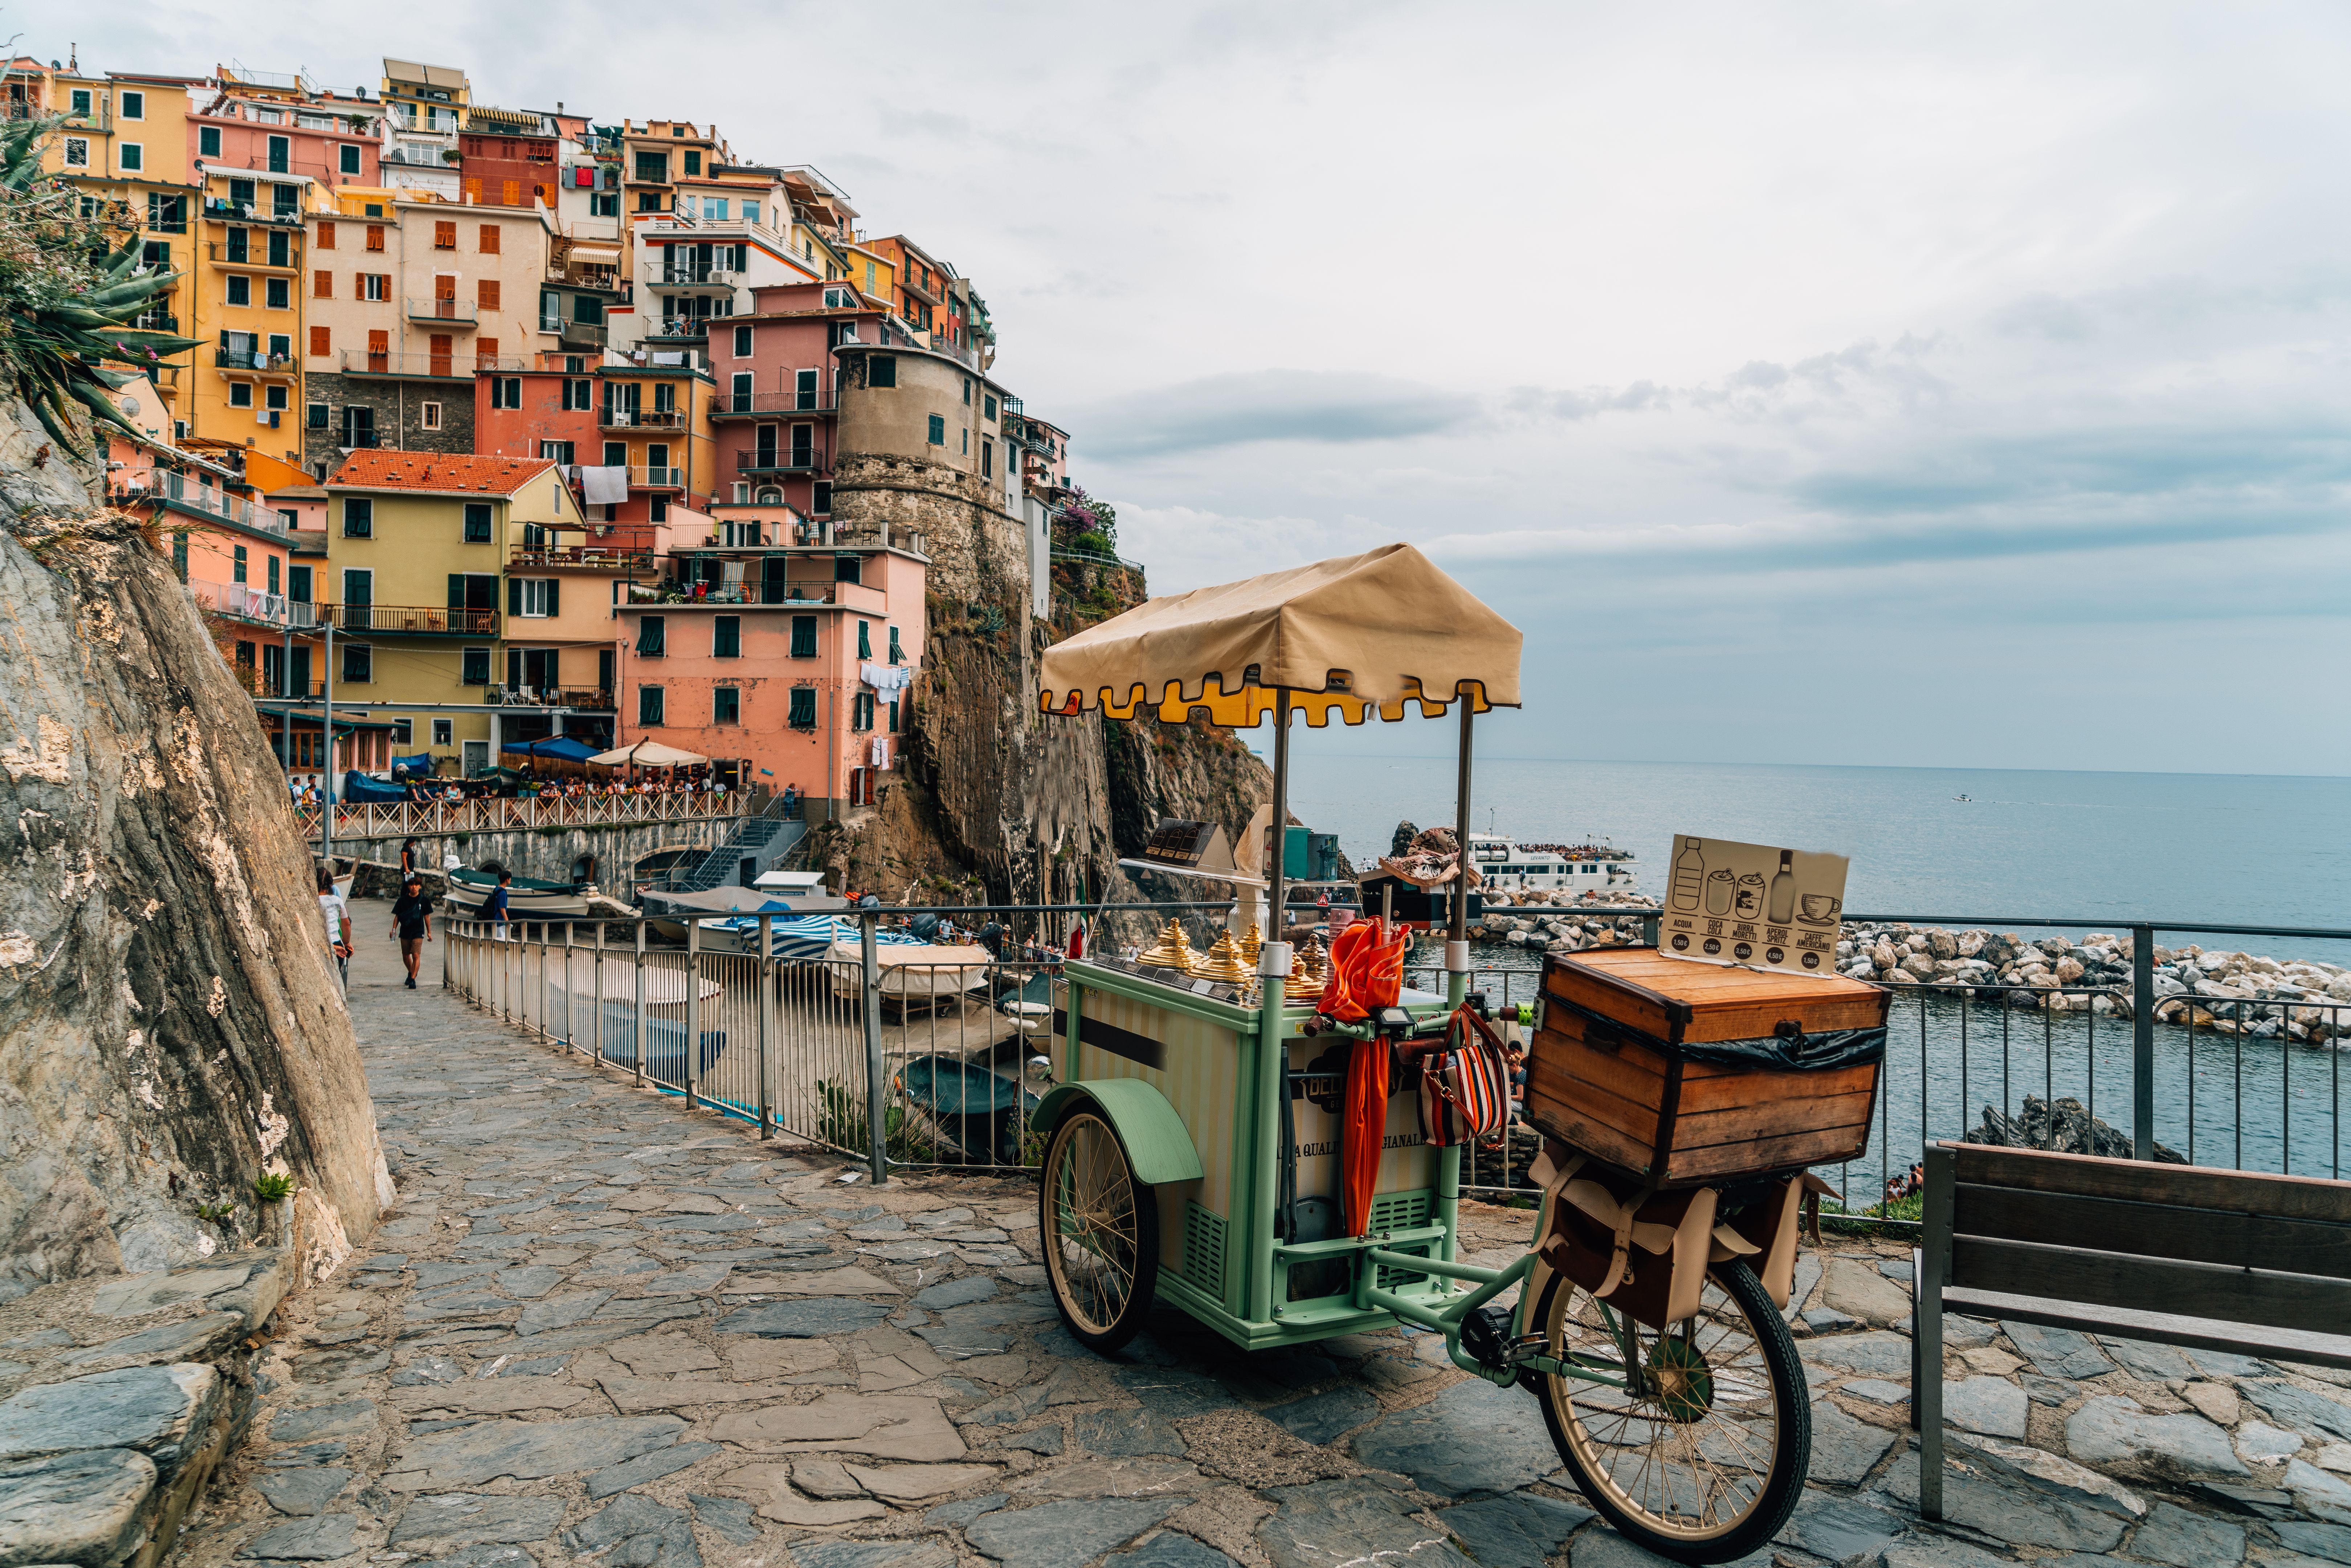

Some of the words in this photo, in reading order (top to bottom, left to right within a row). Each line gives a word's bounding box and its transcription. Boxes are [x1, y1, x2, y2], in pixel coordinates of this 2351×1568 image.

[1673, 919, 1692, 928] ACQUA
[1708, 919, 1723, 928] COCA
[1737, 923, 1754, 932] BIRRA
[1707, 927, 1722, 935] COLA
[1732, 930, 1757, 940] MORETTI
[1766, 927, 1788, 938] APEROL
[1767, 935, 1787, 944] SPRITZ
[1796, 939, 1830, 950] AMERICANO
[1303, 1141, 1340, 1157] QUALI
[1382, 1133, 1426, 1149] GIANAL
